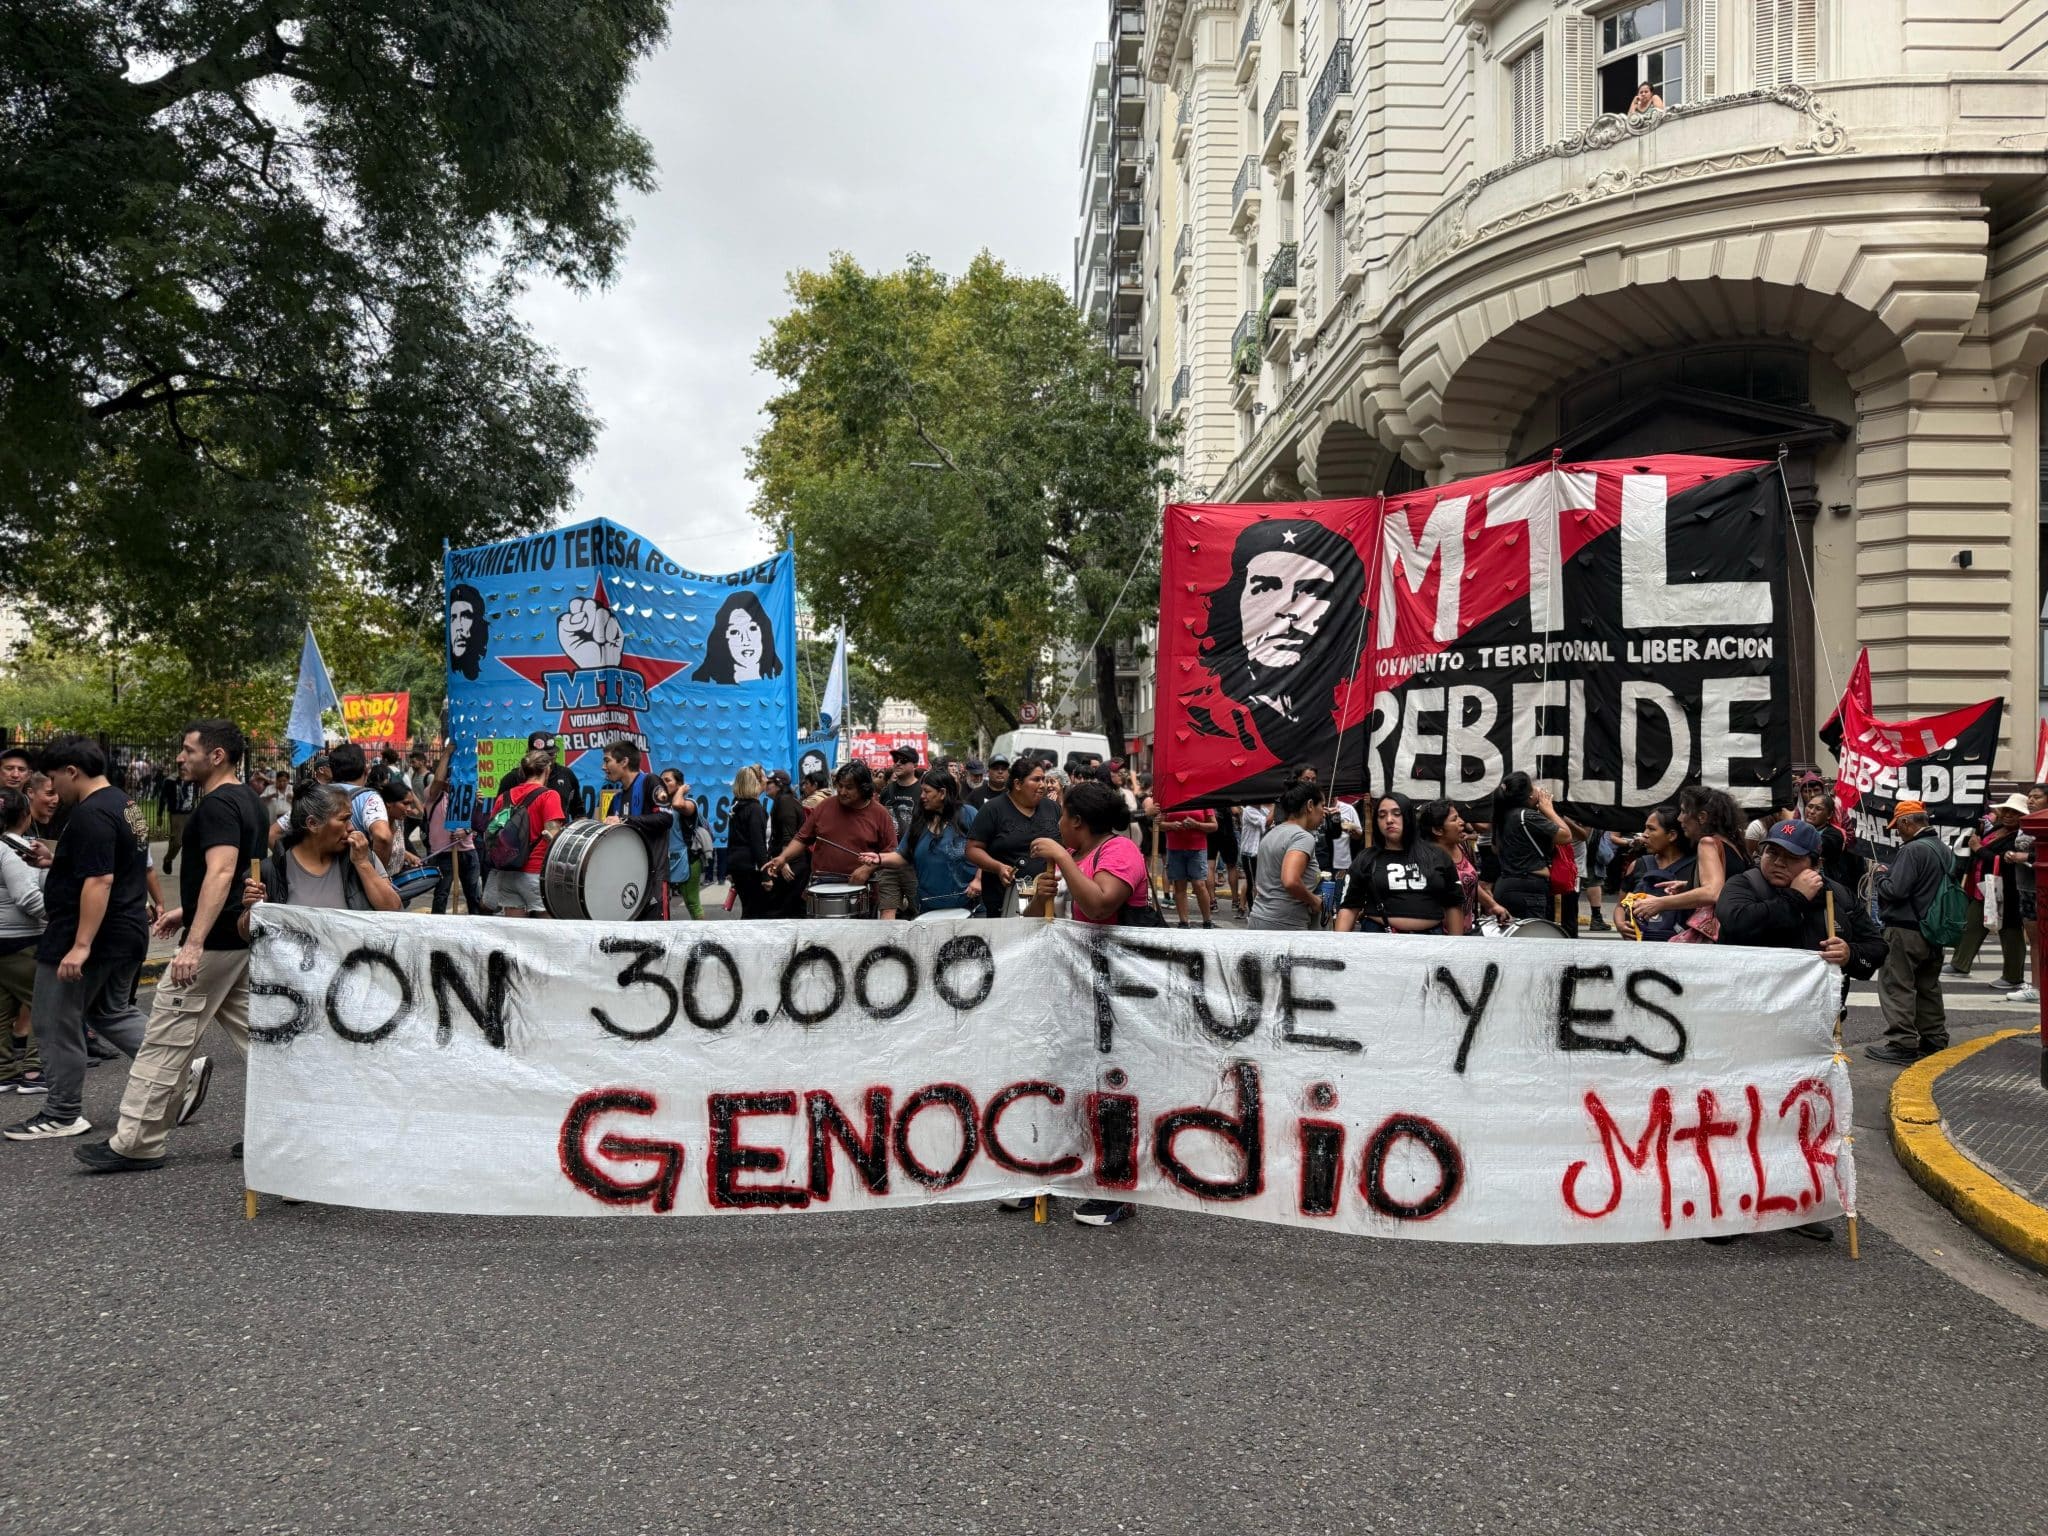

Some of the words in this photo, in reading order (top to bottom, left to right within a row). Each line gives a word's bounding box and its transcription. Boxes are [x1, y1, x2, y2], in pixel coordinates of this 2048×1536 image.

[564, 525, 641, 570] TERESA
[1377, 470, 1773, 650] MTL
[1478, 640, 1614, 668] TERRITORIAL
[543, 668, 648, 710] MTR
[478, 741, 493, 755] NO
[573, 734, 588, 749] EL
[1367, 676, 1772, 809] REBELDE
[479, 760, 494, 772] NO
[479, 776, 494, 788] NO
[1839, 746, 1987, 804] REBELDE
[1387, 863, 1427, 890] 23
[250, 925, 506, 1048] SON
[591, 935, 994, 1040] 30.000
[1091, 940, 1363, 1053] FUE
[1437, 963, 1499, 1073] Y
[1557, 965, 1687, 1064] ES
